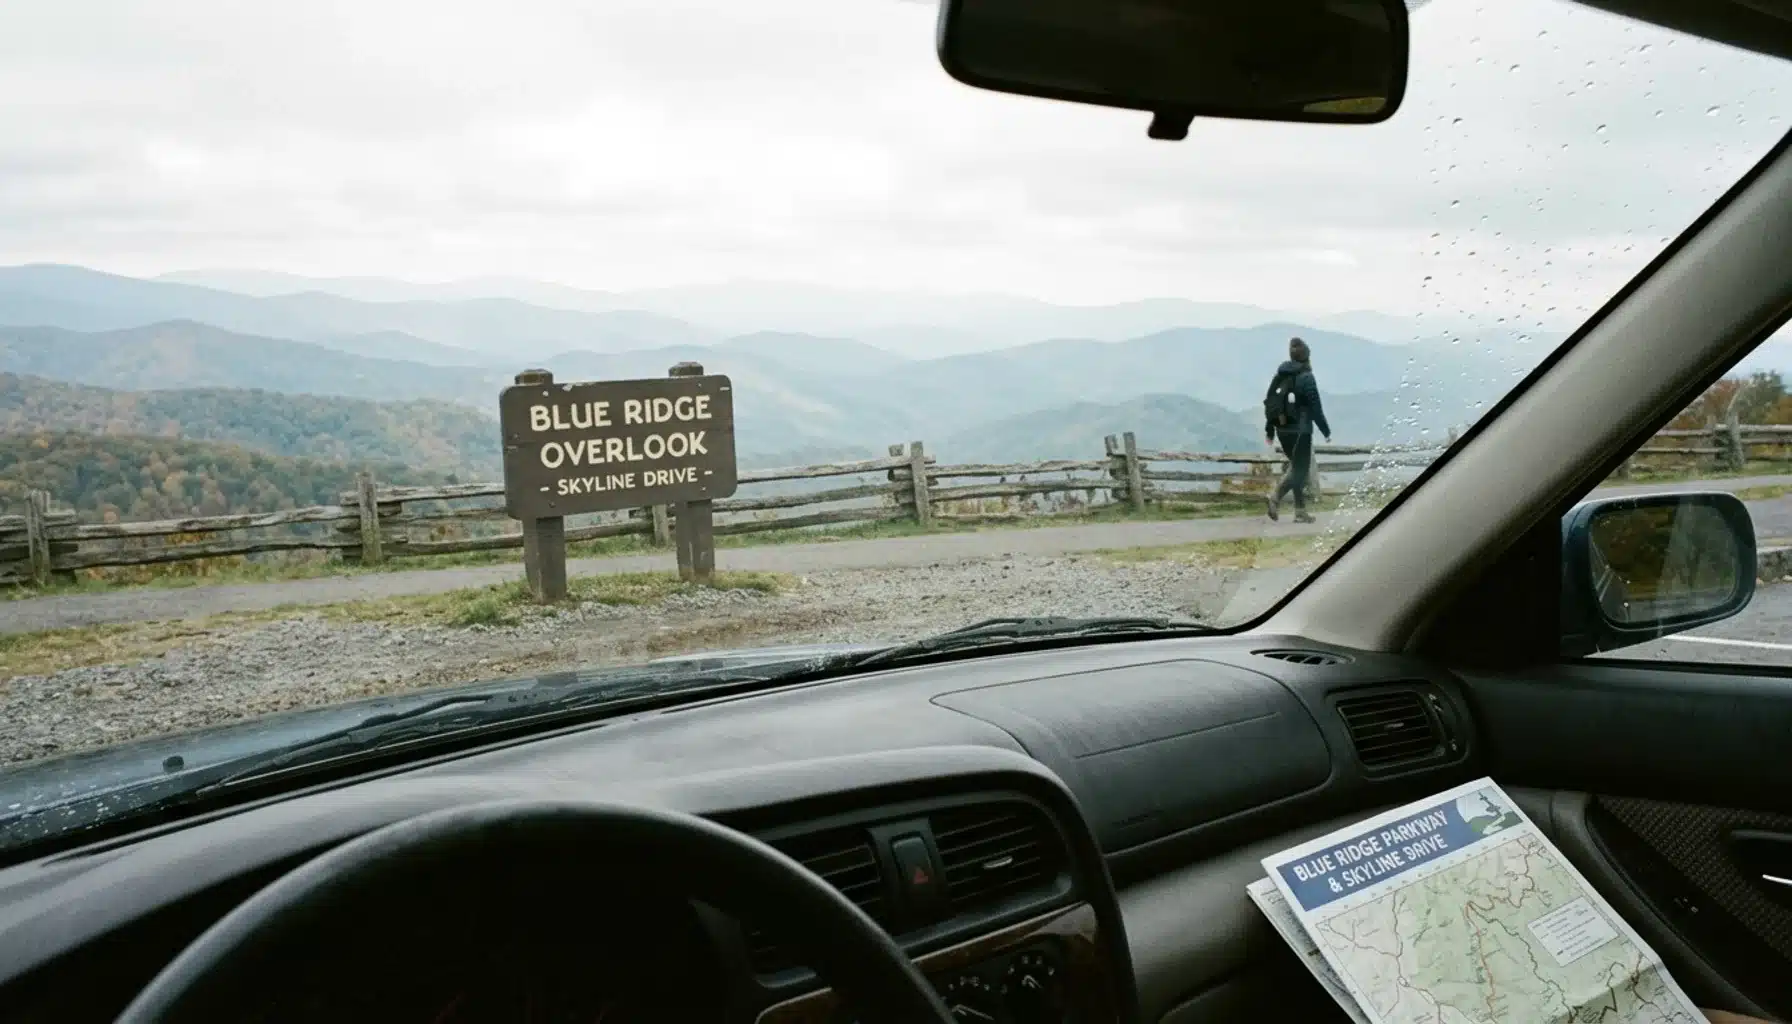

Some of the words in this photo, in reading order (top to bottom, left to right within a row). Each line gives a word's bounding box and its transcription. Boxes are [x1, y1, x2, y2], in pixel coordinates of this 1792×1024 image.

[530, 402, 612, 431] BLUE
[624, 395, 712, 425] RIDGE
[540, 431, 708, 468] OVERLOOK
[557, 473, 636, 496] SKYLINE
[643, 467, 698, 487] DRIVE
[1293, 854, 1336, 882] BLUE
[1334, 836, 1383, 866] RIDGE
[1380, 810, 1448, 847] PARKWAY
[1328, 877, 1343, 893] &
[1342, 851, 1405, 887] SKYLINE
